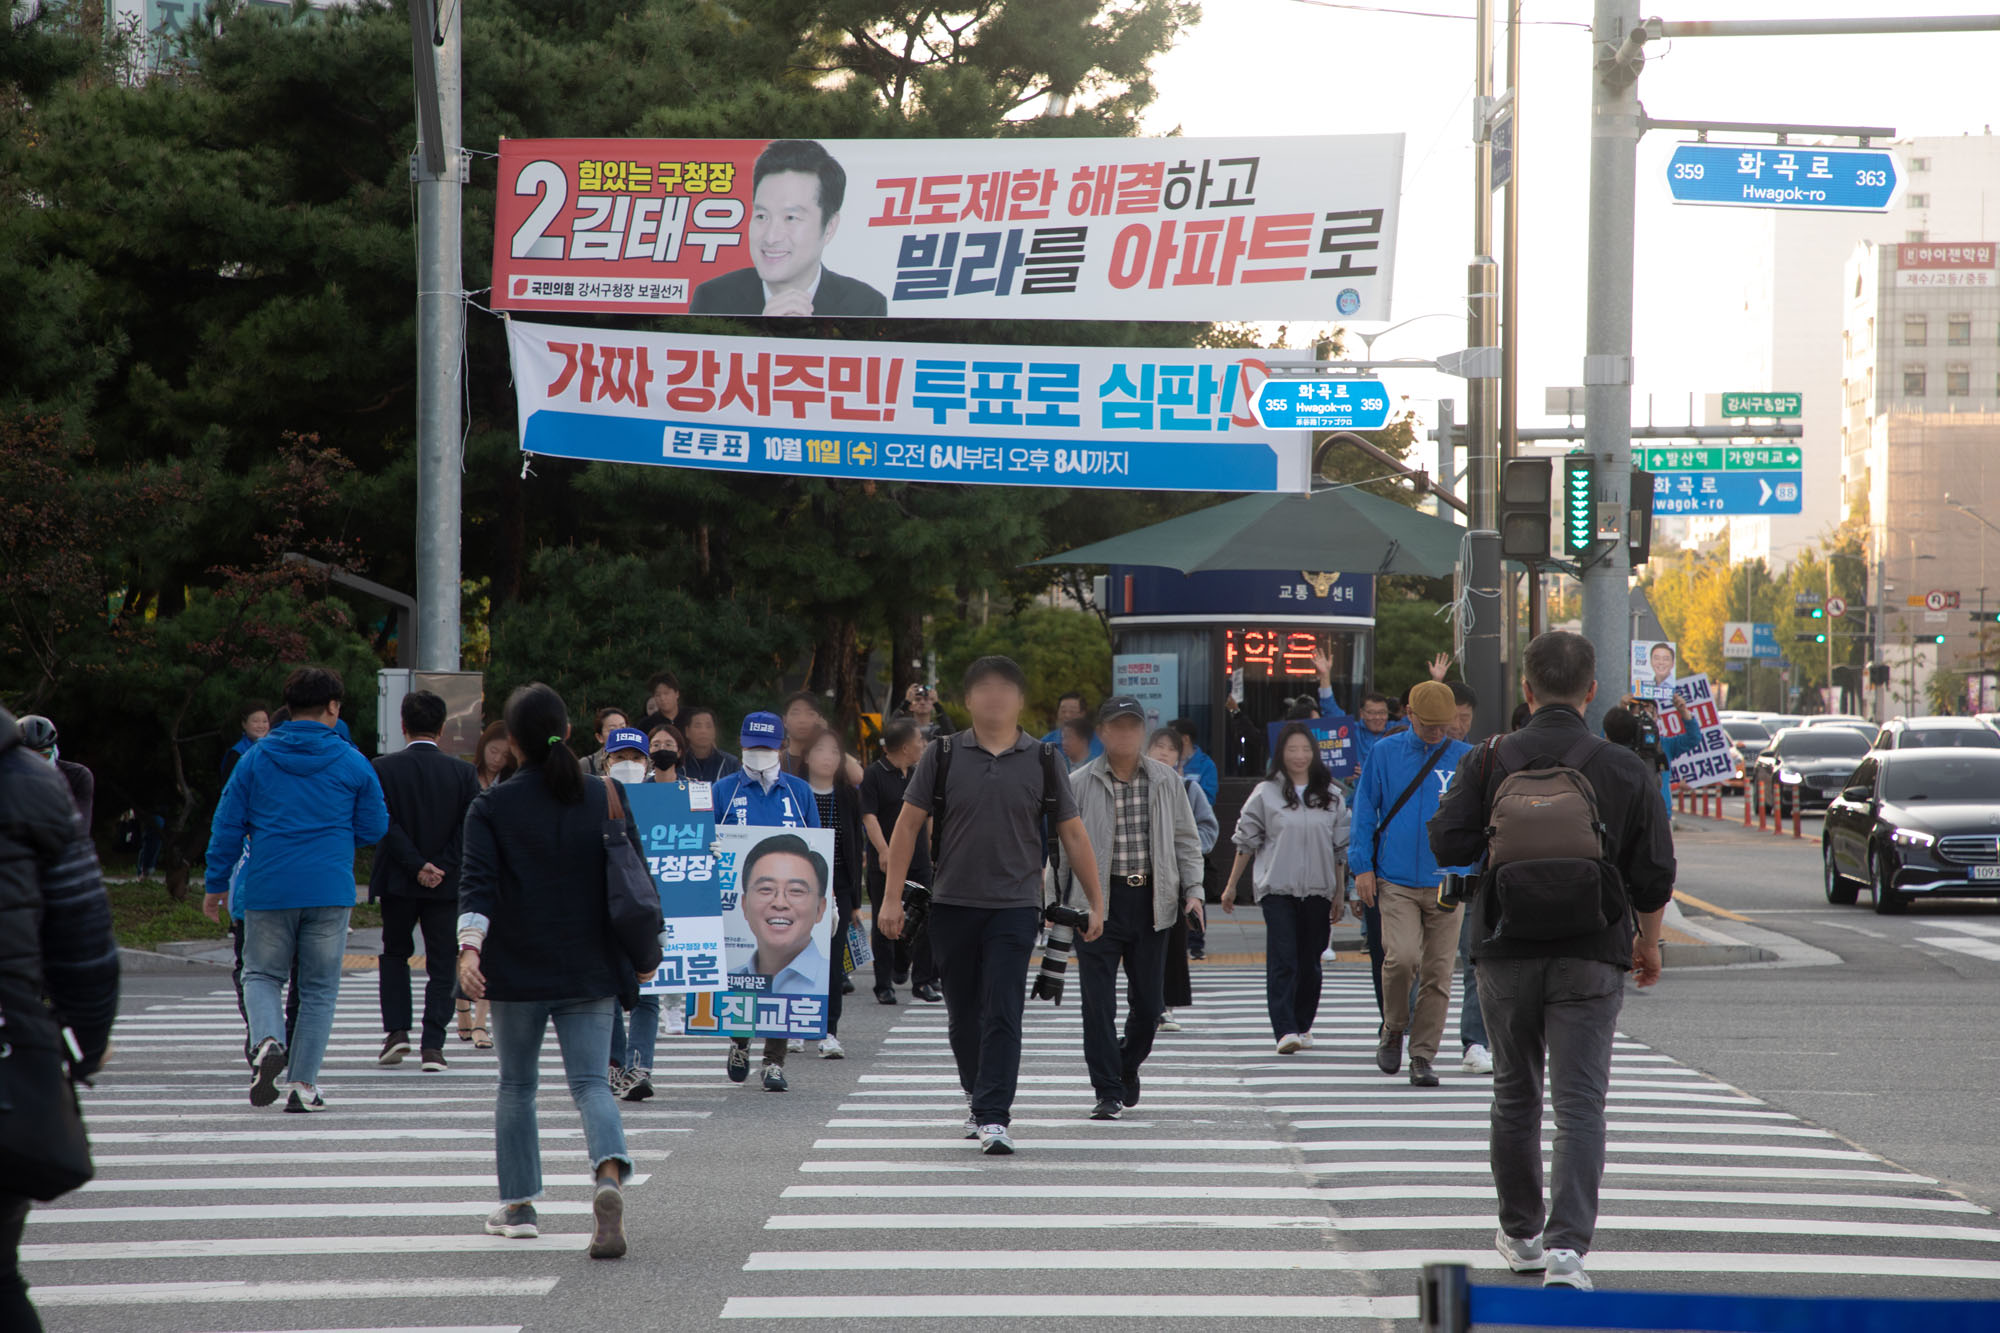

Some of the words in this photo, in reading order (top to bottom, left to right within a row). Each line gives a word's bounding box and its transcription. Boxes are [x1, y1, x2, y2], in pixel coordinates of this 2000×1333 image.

[1674, 163, 1704, 180] 359
[1737, 151, 1834, 182] 화곡로
[578, 159, 652, 193] 힘있는
[658, 161, 736, 194] 구청장
[1856, 170, 1887, 187] 363
[868, 167, 1058, 227] 고도제한
[1067, 156, 1260, 218] 해결하고
[1743, 184, 1826, 202] Hwagok-ro
[511, 159, 568, 260] 2
[567, 194, 745, 263] 김태우
[892, 225, 1088, 301] 빌라를
[1106, 207, 1384, 290] 아파트로
[531, 281, 574, 296] 국민의힘
[578, 282, 634, 298] 강서구청장
[637, 284, 683, 299] 보궐선거
[546, 340, 654, 407] 가짜
[666, 348, 904, 422] 강서주민!
[912, 358, 1080, 428] 투표로
[1099, 361, 1242, 432] 심판!
[1298, 383, 1350, 400] 화곡로
[1265, 399, 1287, 411] 355
[1296, 402, 1352, 414] Hwagok-ro
[1360, 398, 1383, 411] 359
[672, 430, 743, 457] 본투표
[763, 436, 802, 462] 10월
[806, 439, 840, 464] 11일
[884, 443, 925, 469] 오전
[930, 444, 1003, 471] 6시부터
[1008, 447, 1049, 473] 오후
[1054, 449, 1128, 475] 8시까지
[1666, 452, 1708, 466] 발산역
[1729, 451, 1783, 466] 가양대교
[1654, 476, 1718, 496] 화곡로
[1778, 487, 1794, 498] 88
[1653, 498, 1724, 511] wagok-ro
[1278, 584, 1308, 600] 교통
[781, 796, 793, 817] 1
[640, 954, 719, 989] 교훈
[721, 995, 822, 1034] 진교훈
